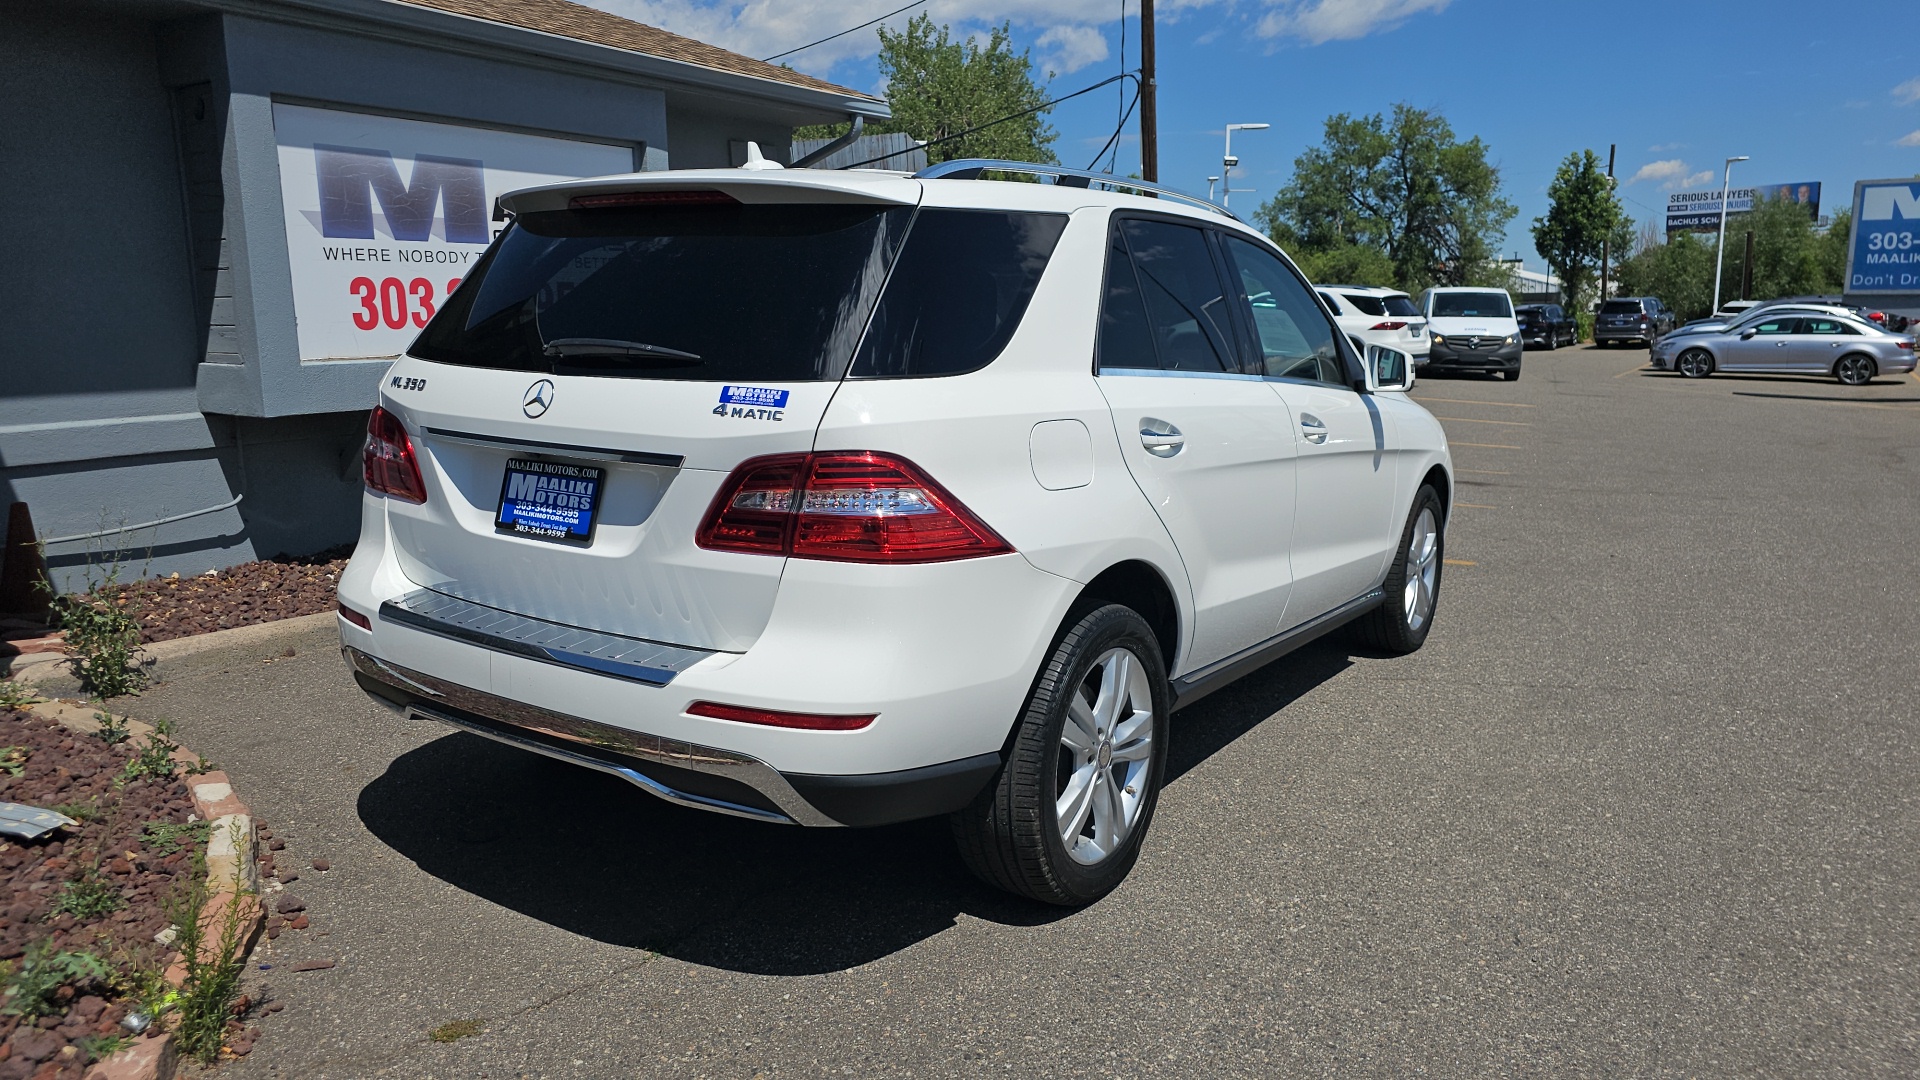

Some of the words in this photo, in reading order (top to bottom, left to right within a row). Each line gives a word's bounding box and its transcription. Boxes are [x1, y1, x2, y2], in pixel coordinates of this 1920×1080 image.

[1671, 192, 1708, 203] SERIOUS
[1668, 217, 1699, 226] BACHUS
[323, 247, 391, 262] WHERE
[399, 249, 469, 264] NOBODY
[1853, 273, 1894, 286] Don't
[507, 460, 544, 472] MAALIKI
[508, 473, 594, 501] MAALIKI
[516, 501, 579, 518] 303-344-9595
[514, 524, 566, 539] 303-344-9595
